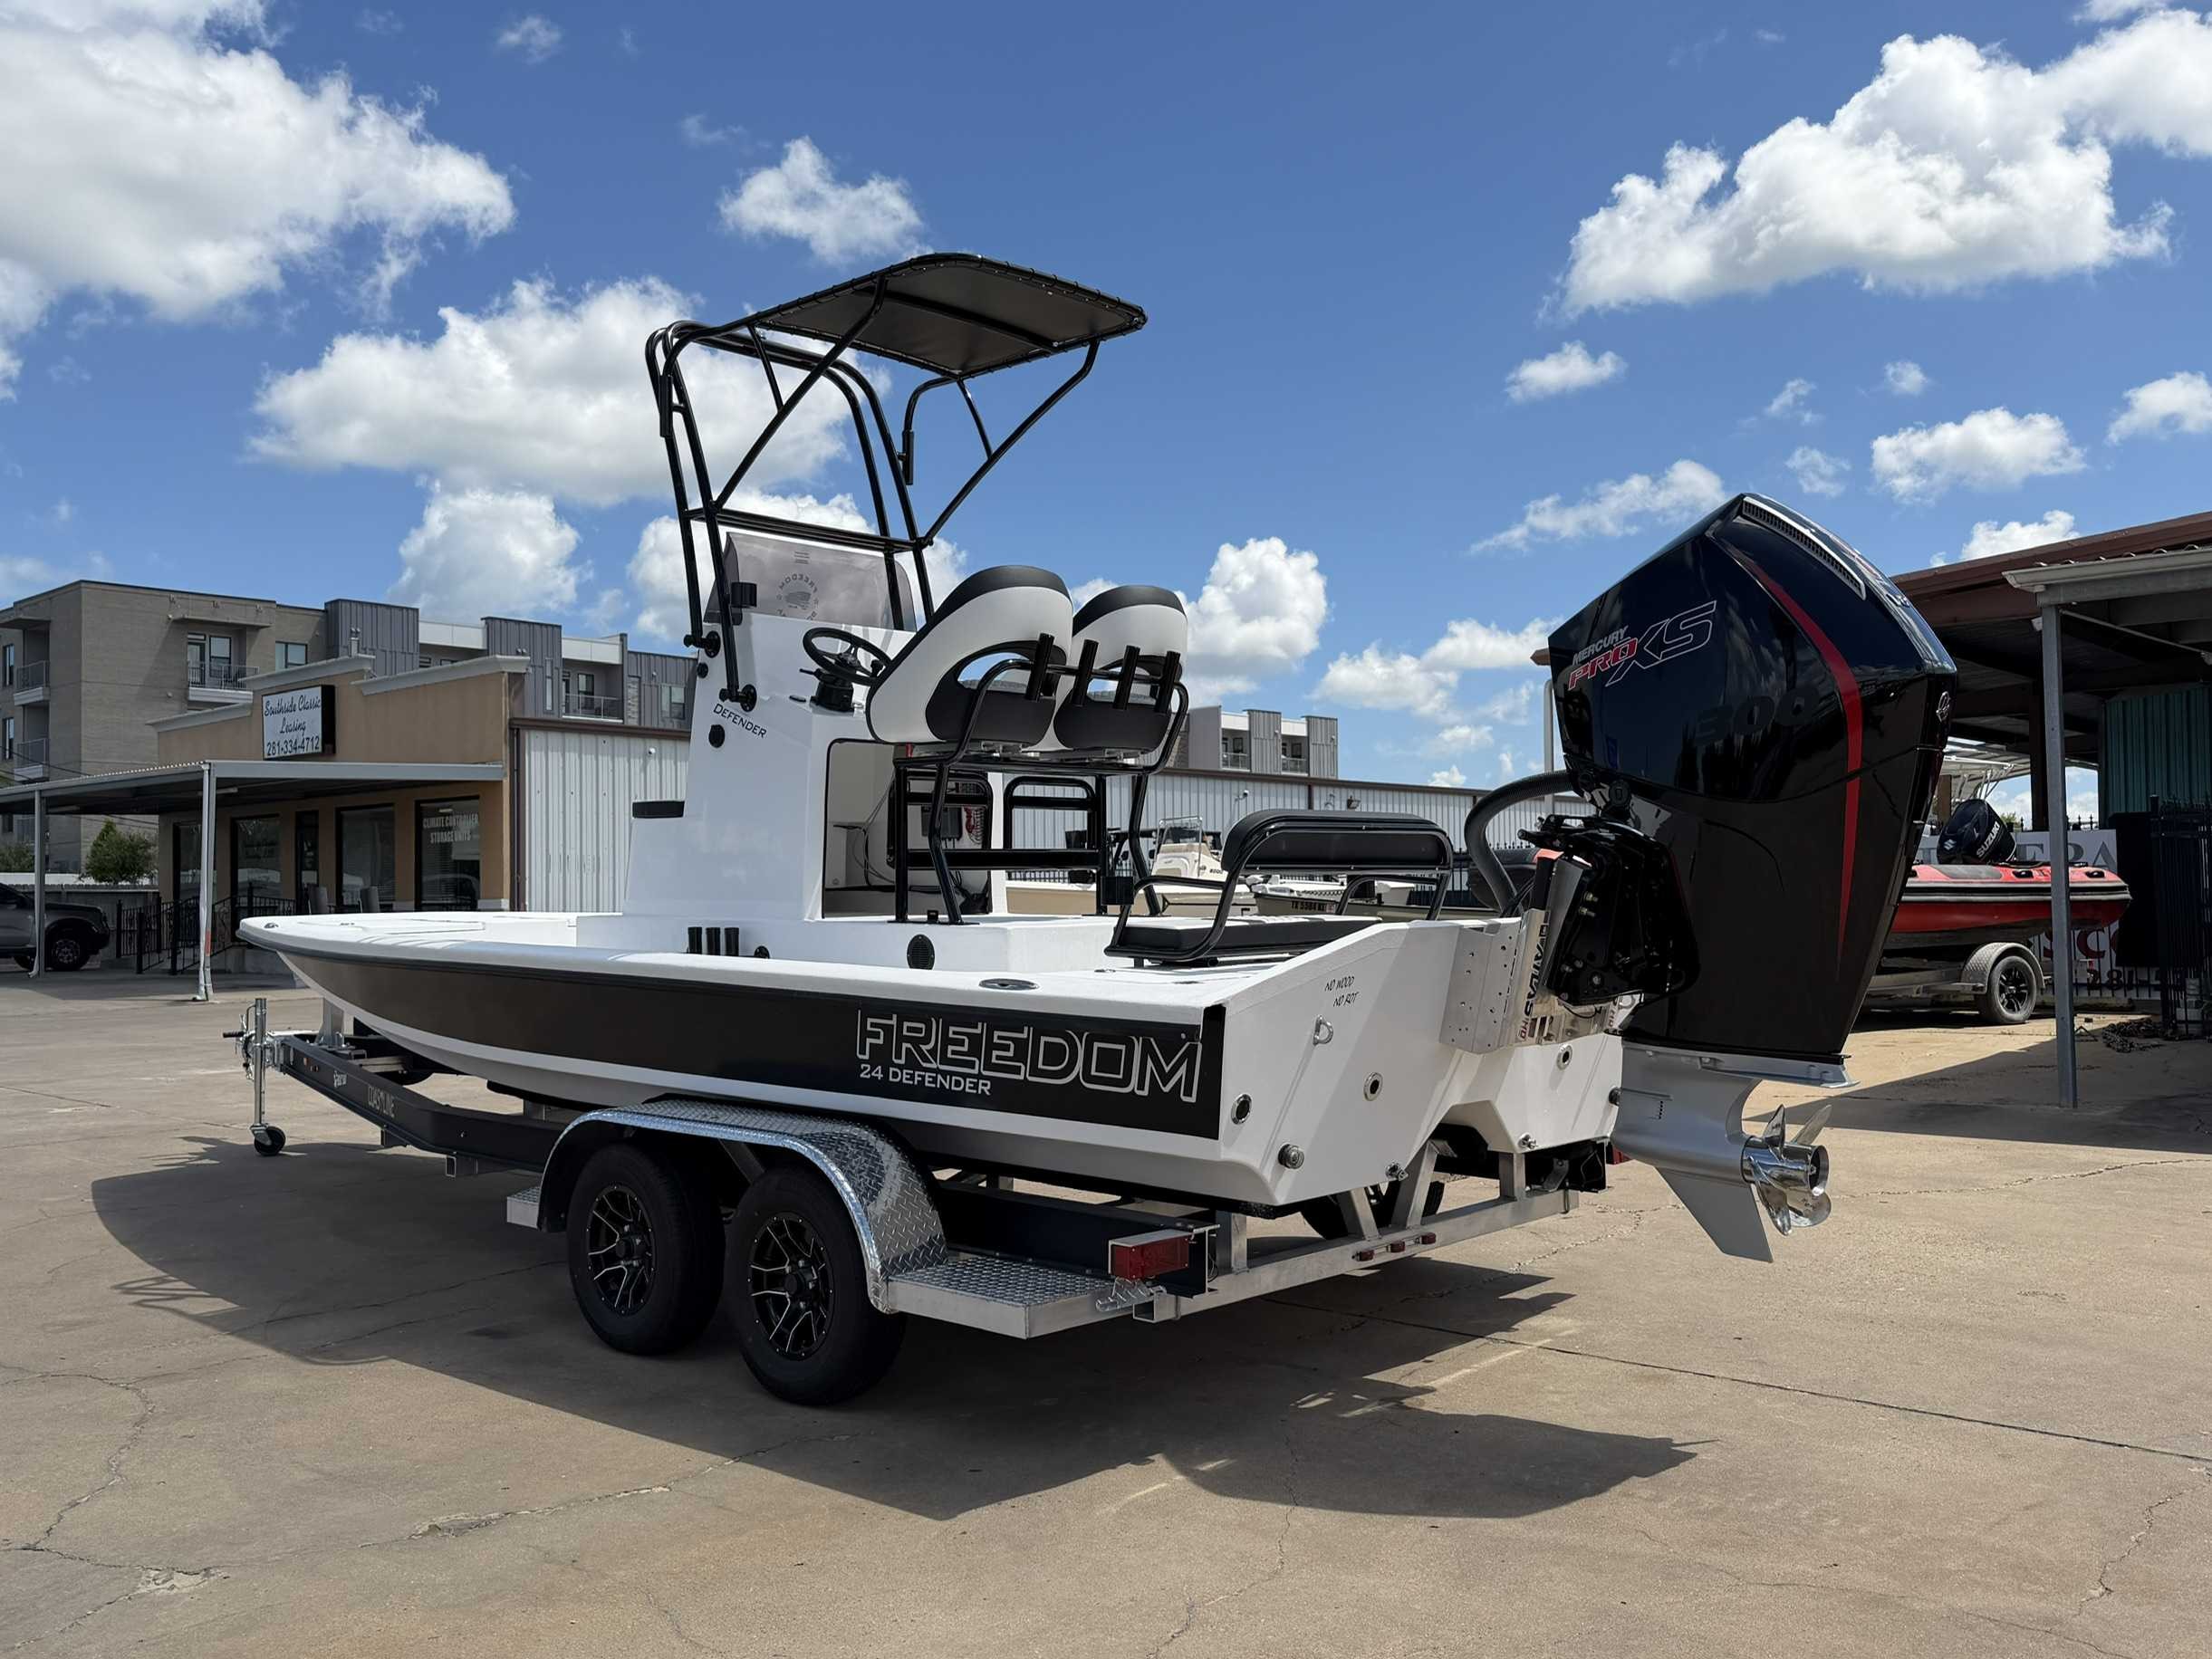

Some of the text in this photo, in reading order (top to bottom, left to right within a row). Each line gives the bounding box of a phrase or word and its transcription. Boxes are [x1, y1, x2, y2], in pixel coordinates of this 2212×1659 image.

[1568, 600, 1717, 691] PRO XS
[1572, 625, 1630, 666] MERCURY
[264, 695, 321, 716] Southside Classic
[713, 703, 767, 738] DEFENDER
[280, 717, 306, 736] Leasing
[422, 817, 445, 829] CLIMATE
[430, 829, 471, 844] STORAGE UNITS
[1976, 820, 2000, 858] SUZUKI
[1324, 975, 1355, 992] NO WOOD
[1524, 942, 1544, 1016] ATLAS
[1332, 994, 1344, 1007] NO
[856, 1009, 1203, 1103] FREEDOM
[860, 1063, 992, 1096] 24 DEFENDER
